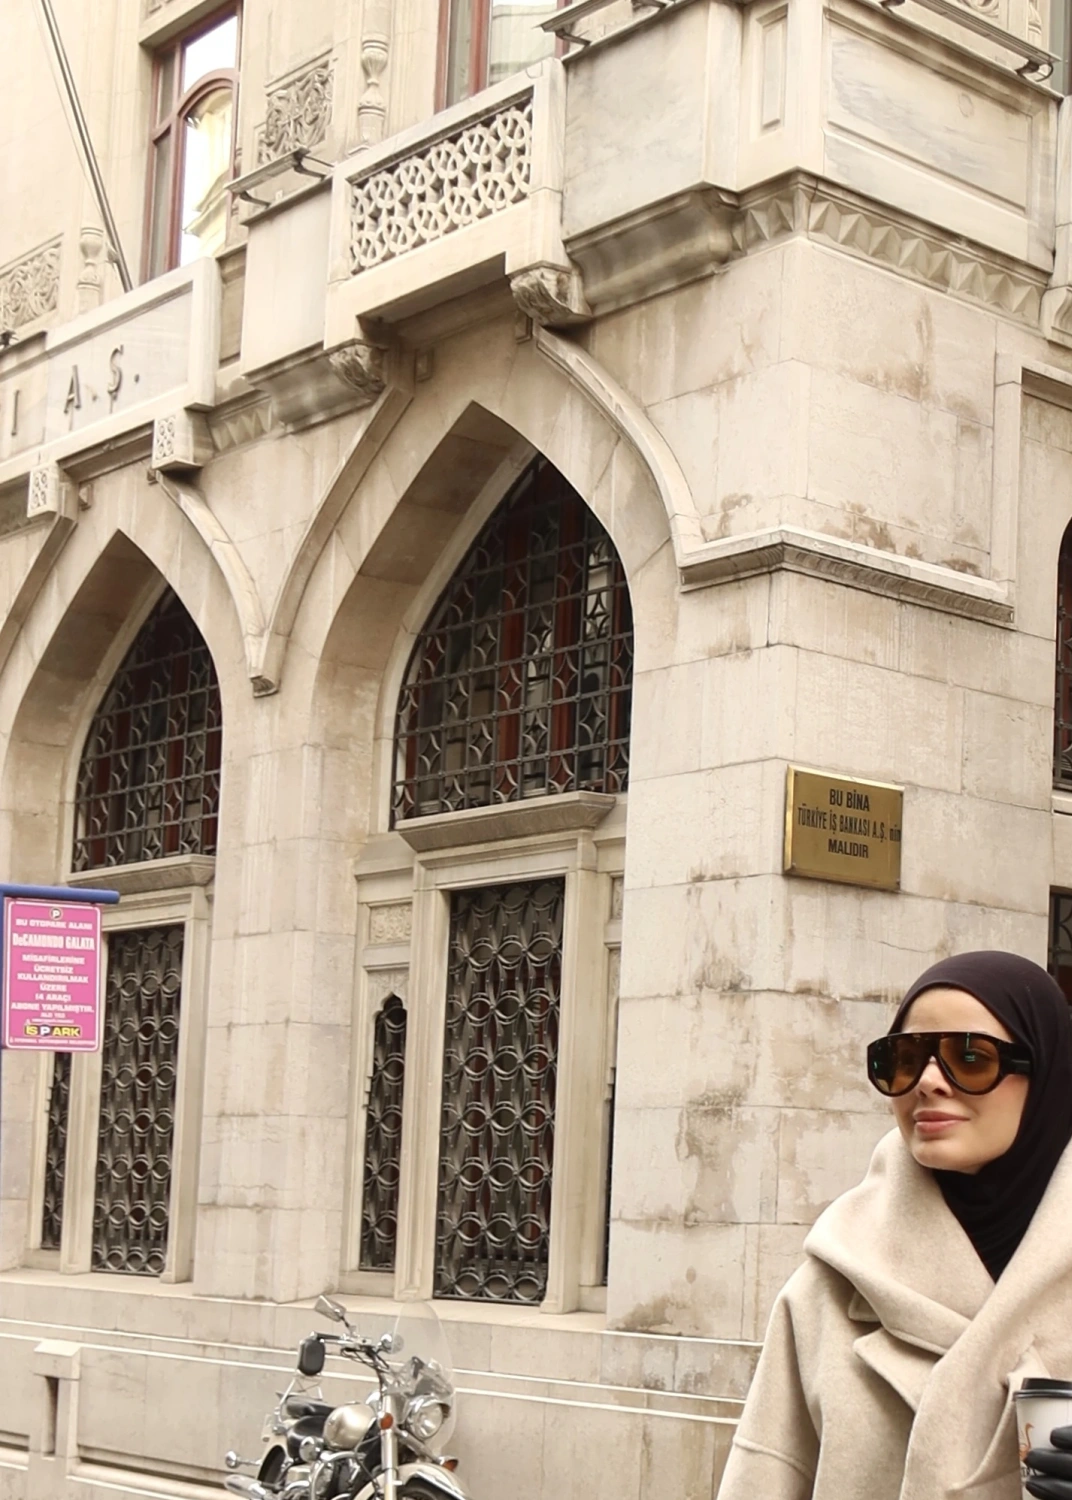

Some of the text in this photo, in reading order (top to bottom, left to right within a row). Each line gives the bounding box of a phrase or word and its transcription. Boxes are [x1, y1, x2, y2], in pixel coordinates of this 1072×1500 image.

[829, 788, 870, 812] BU BİNA
[797, 803, 827, 829] TÜRKİYE
[829, 809, 837, 835] İŞ
[839, 814, 870, 837] BANKASI
[828, 838, 869, 859] MALIDIR
[15, 918, 93, 930] BU OTOPARK ALANI
[12, 932, 95, 951] DeCAMONDO GALATA
[11, 1002, 40, 1010] ABONE
